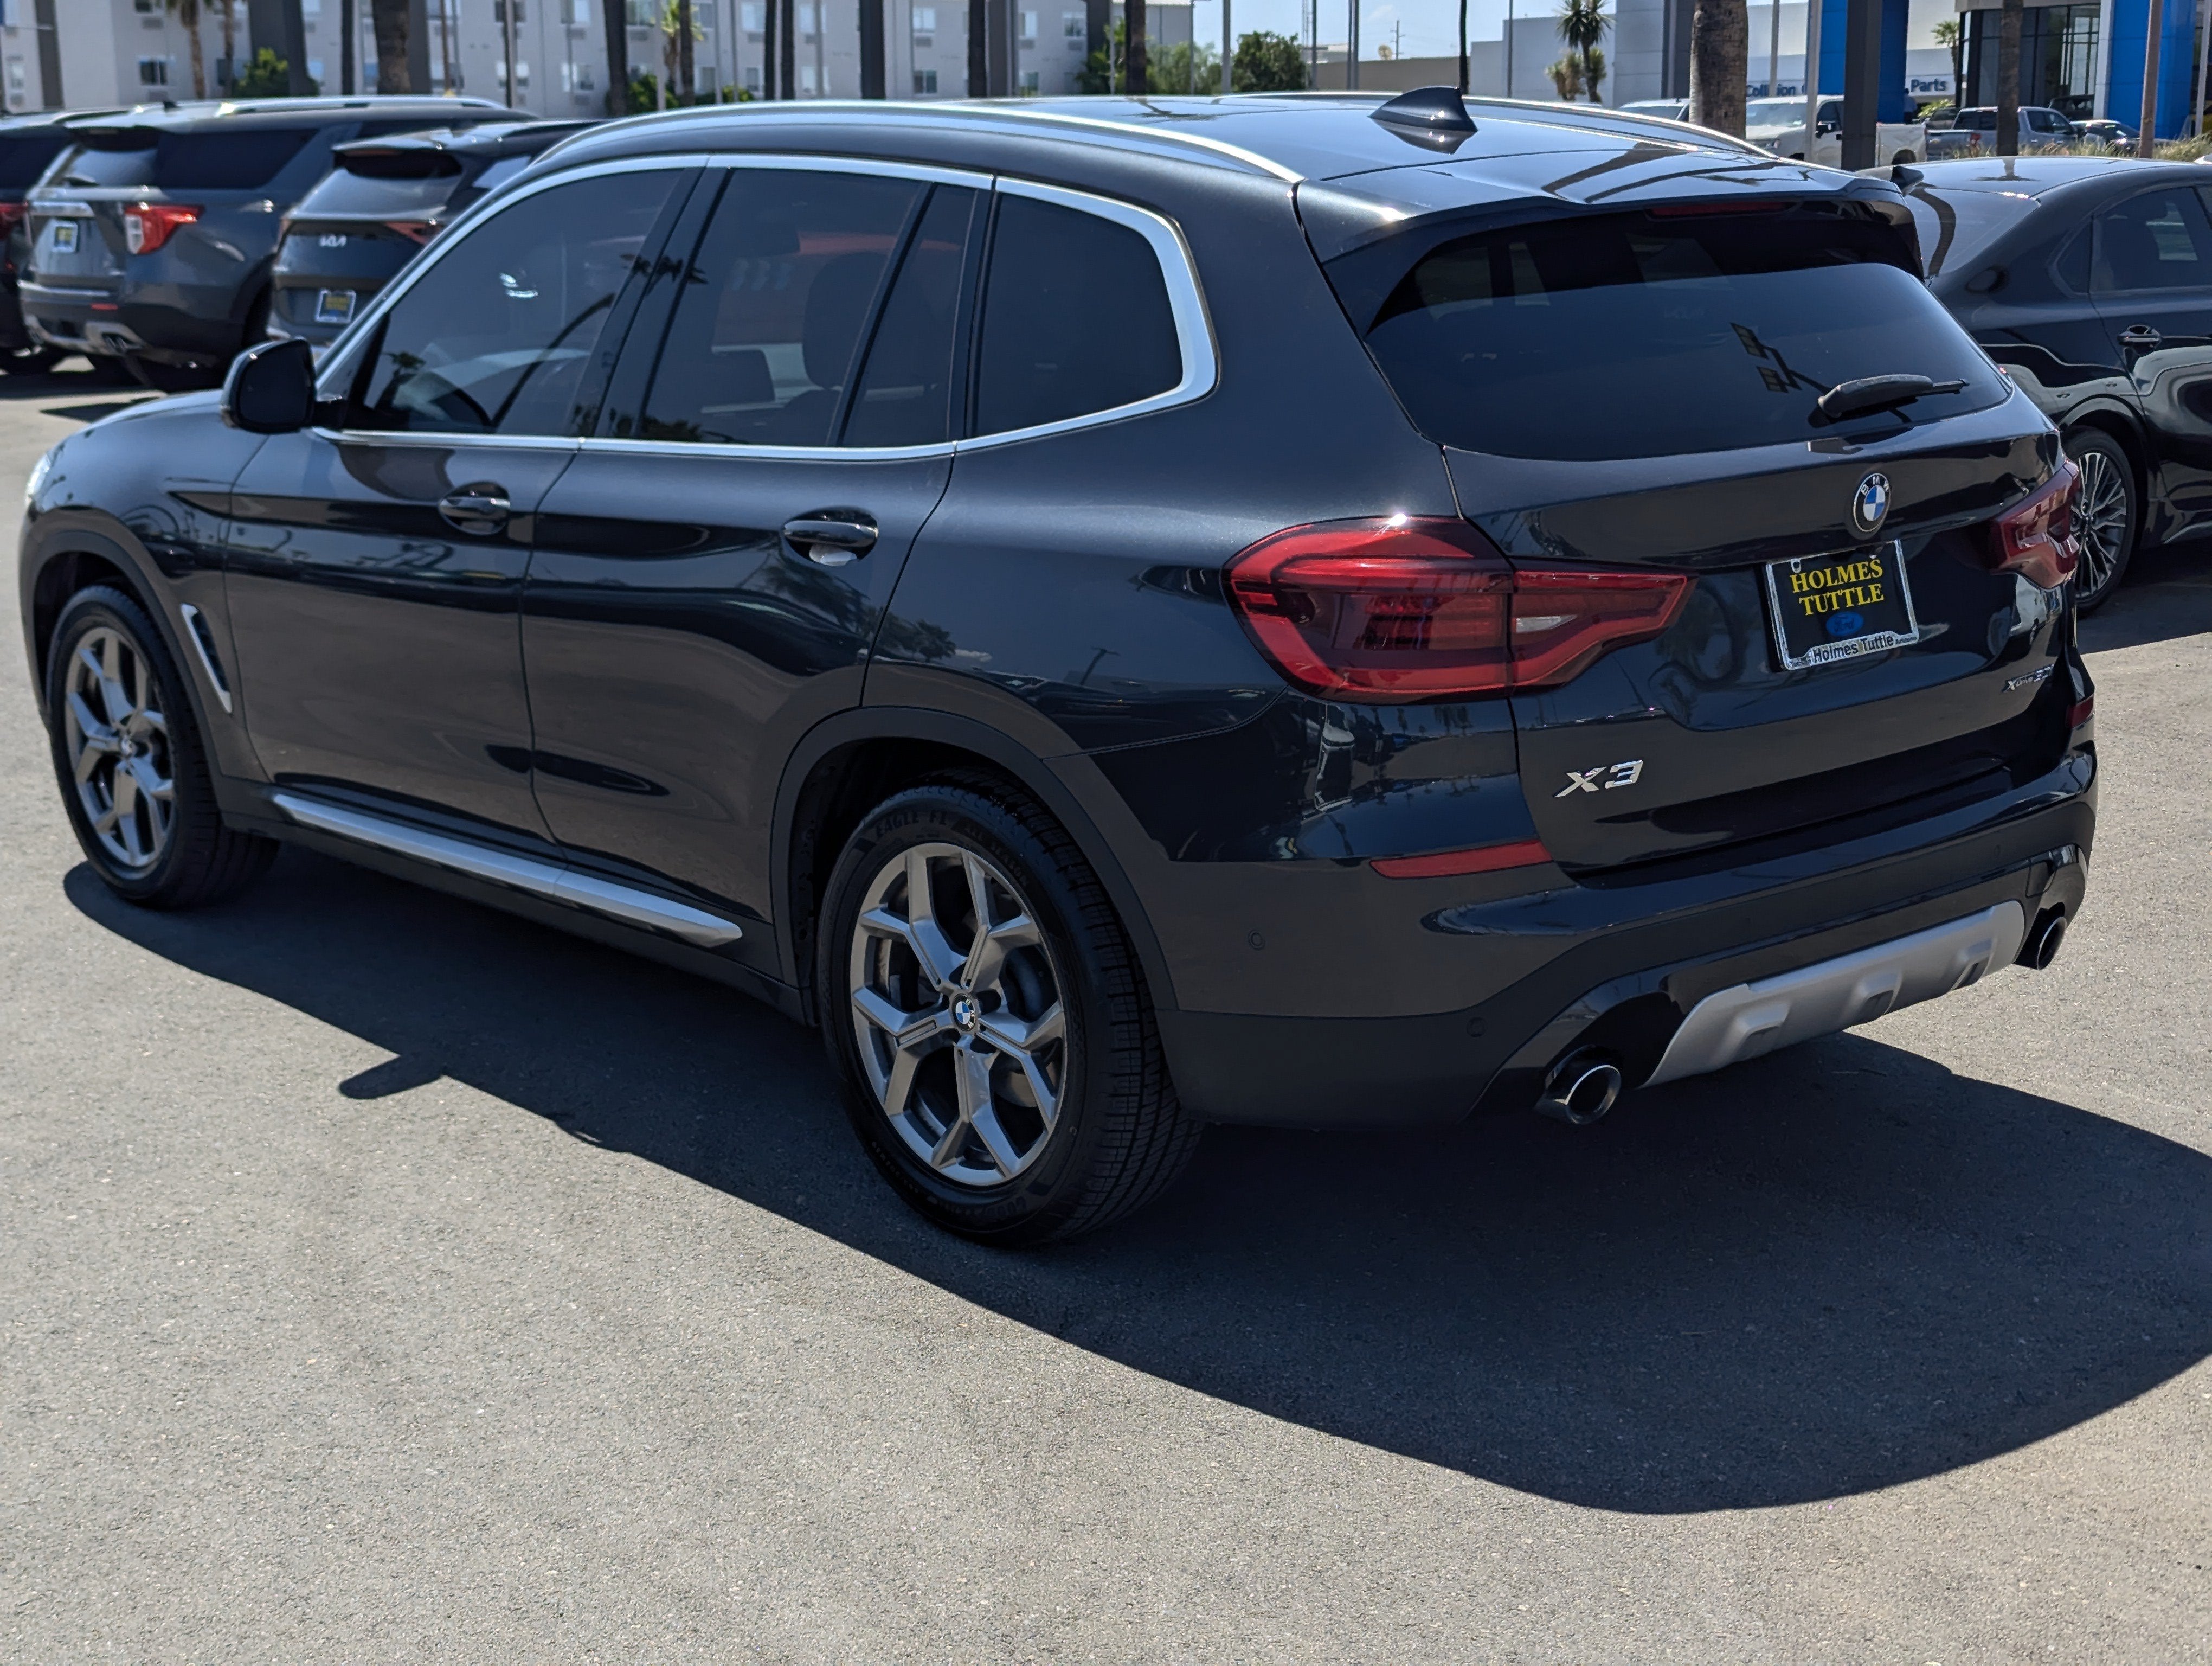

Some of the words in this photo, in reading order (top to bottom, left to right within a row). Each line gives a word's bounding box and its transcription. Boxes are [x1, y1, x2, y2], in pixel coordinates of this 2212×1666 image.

[1746, 83, 1796, 97] Collion
[1911, 78, 1947, 92] Parts
[1790, 559, 1883, 593] HOLMES
[1799, 583, 1885, 616] TUTTLE
[1812, 644, 1859, 663] Holmes
[1861, 634, 1894, 652] Tuttle
[1554, 759, 1643, 798] X3
[875, 811, 919, 838] EAGLE
